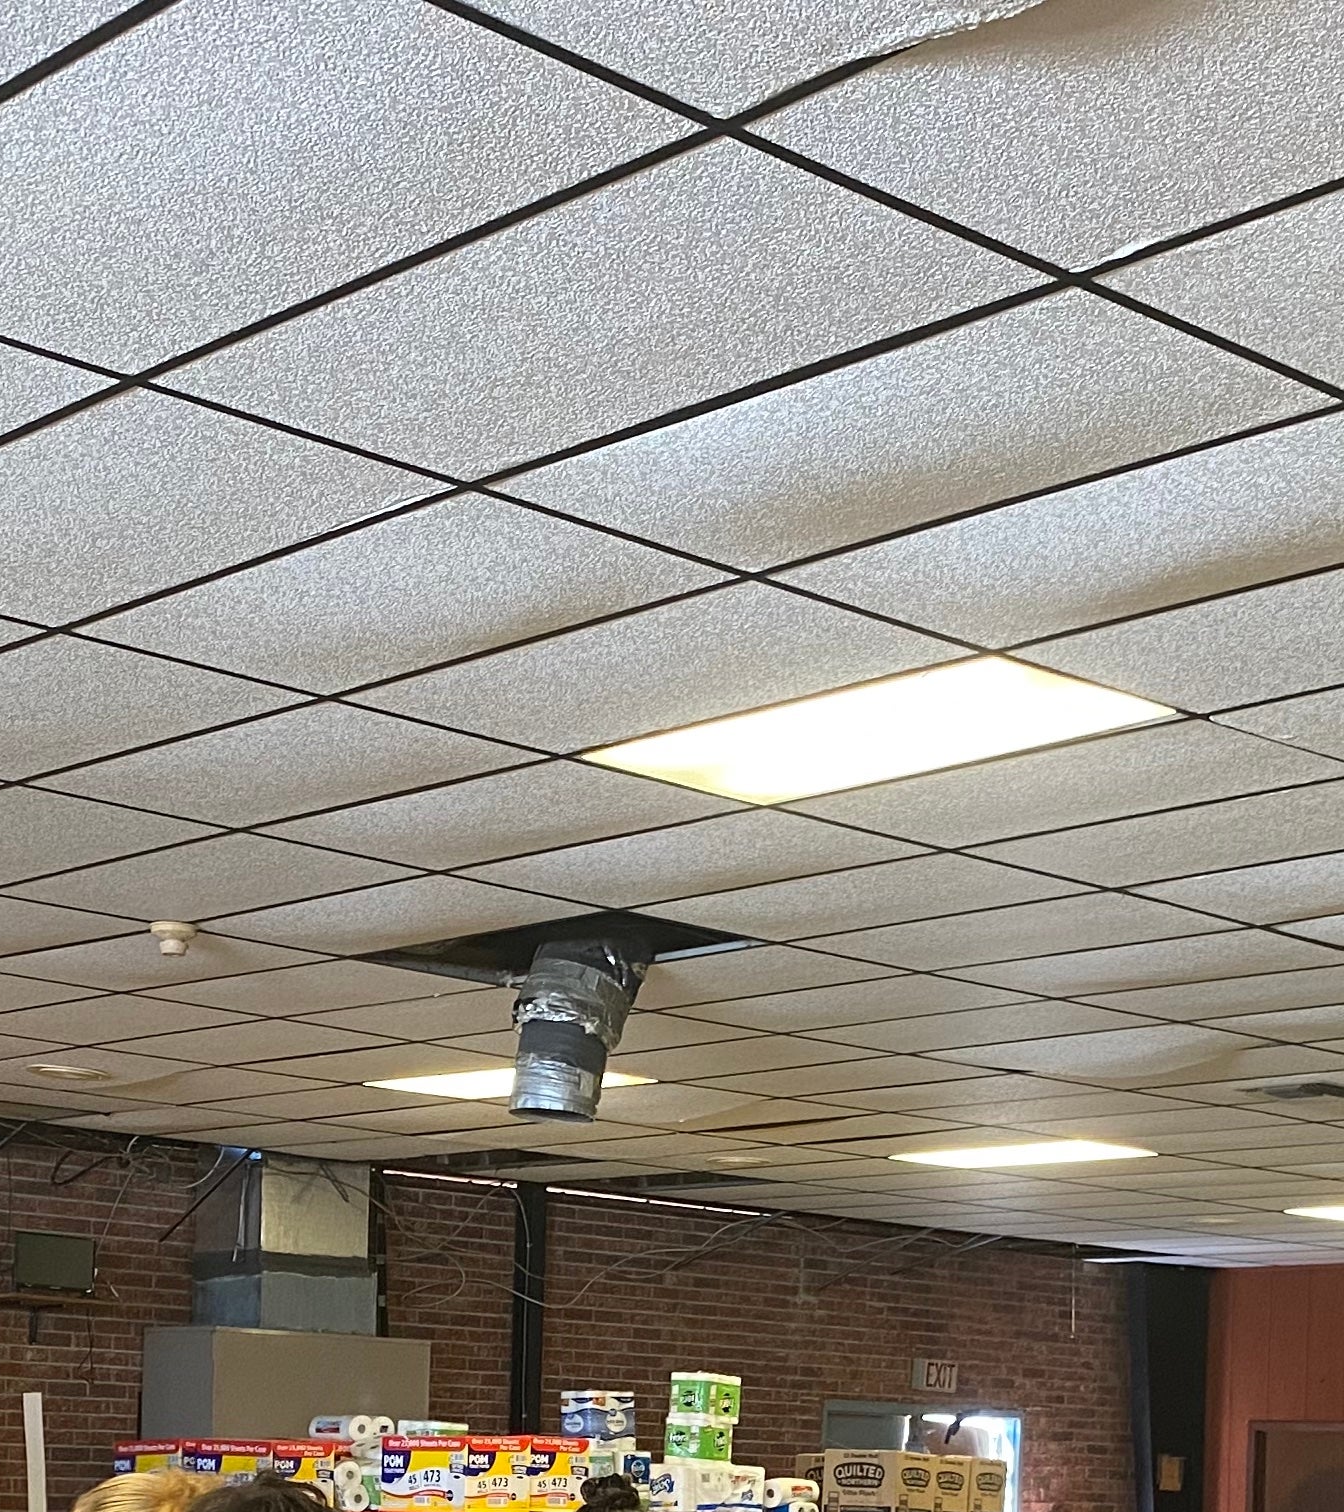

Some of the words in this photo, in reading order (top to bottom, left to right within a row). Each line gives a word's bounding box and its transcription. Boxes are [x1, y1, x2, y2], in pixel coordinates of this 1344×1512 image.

[925, 1362, 955, 1389] EXIT
[196, 1458, 216, 1470] POM
[274, 1459, 294, 1469] POM
[383, 1454, 404, 1467] POM
[469, 1453, 489, 1465] POM
[530, 1453, 549, 1465] POM
[423, 1469, 441, 1483] 473
[835, 1464, 884, 1480] QUILTED
[902, 1470, 930, 1481] QUILTED
[477, 1481, 487, 1489] 45
[491, 1478, 508, 1488] 473
[537, 1480, 547, 1489] 45
[551, 1477, 568, 1488] 473
